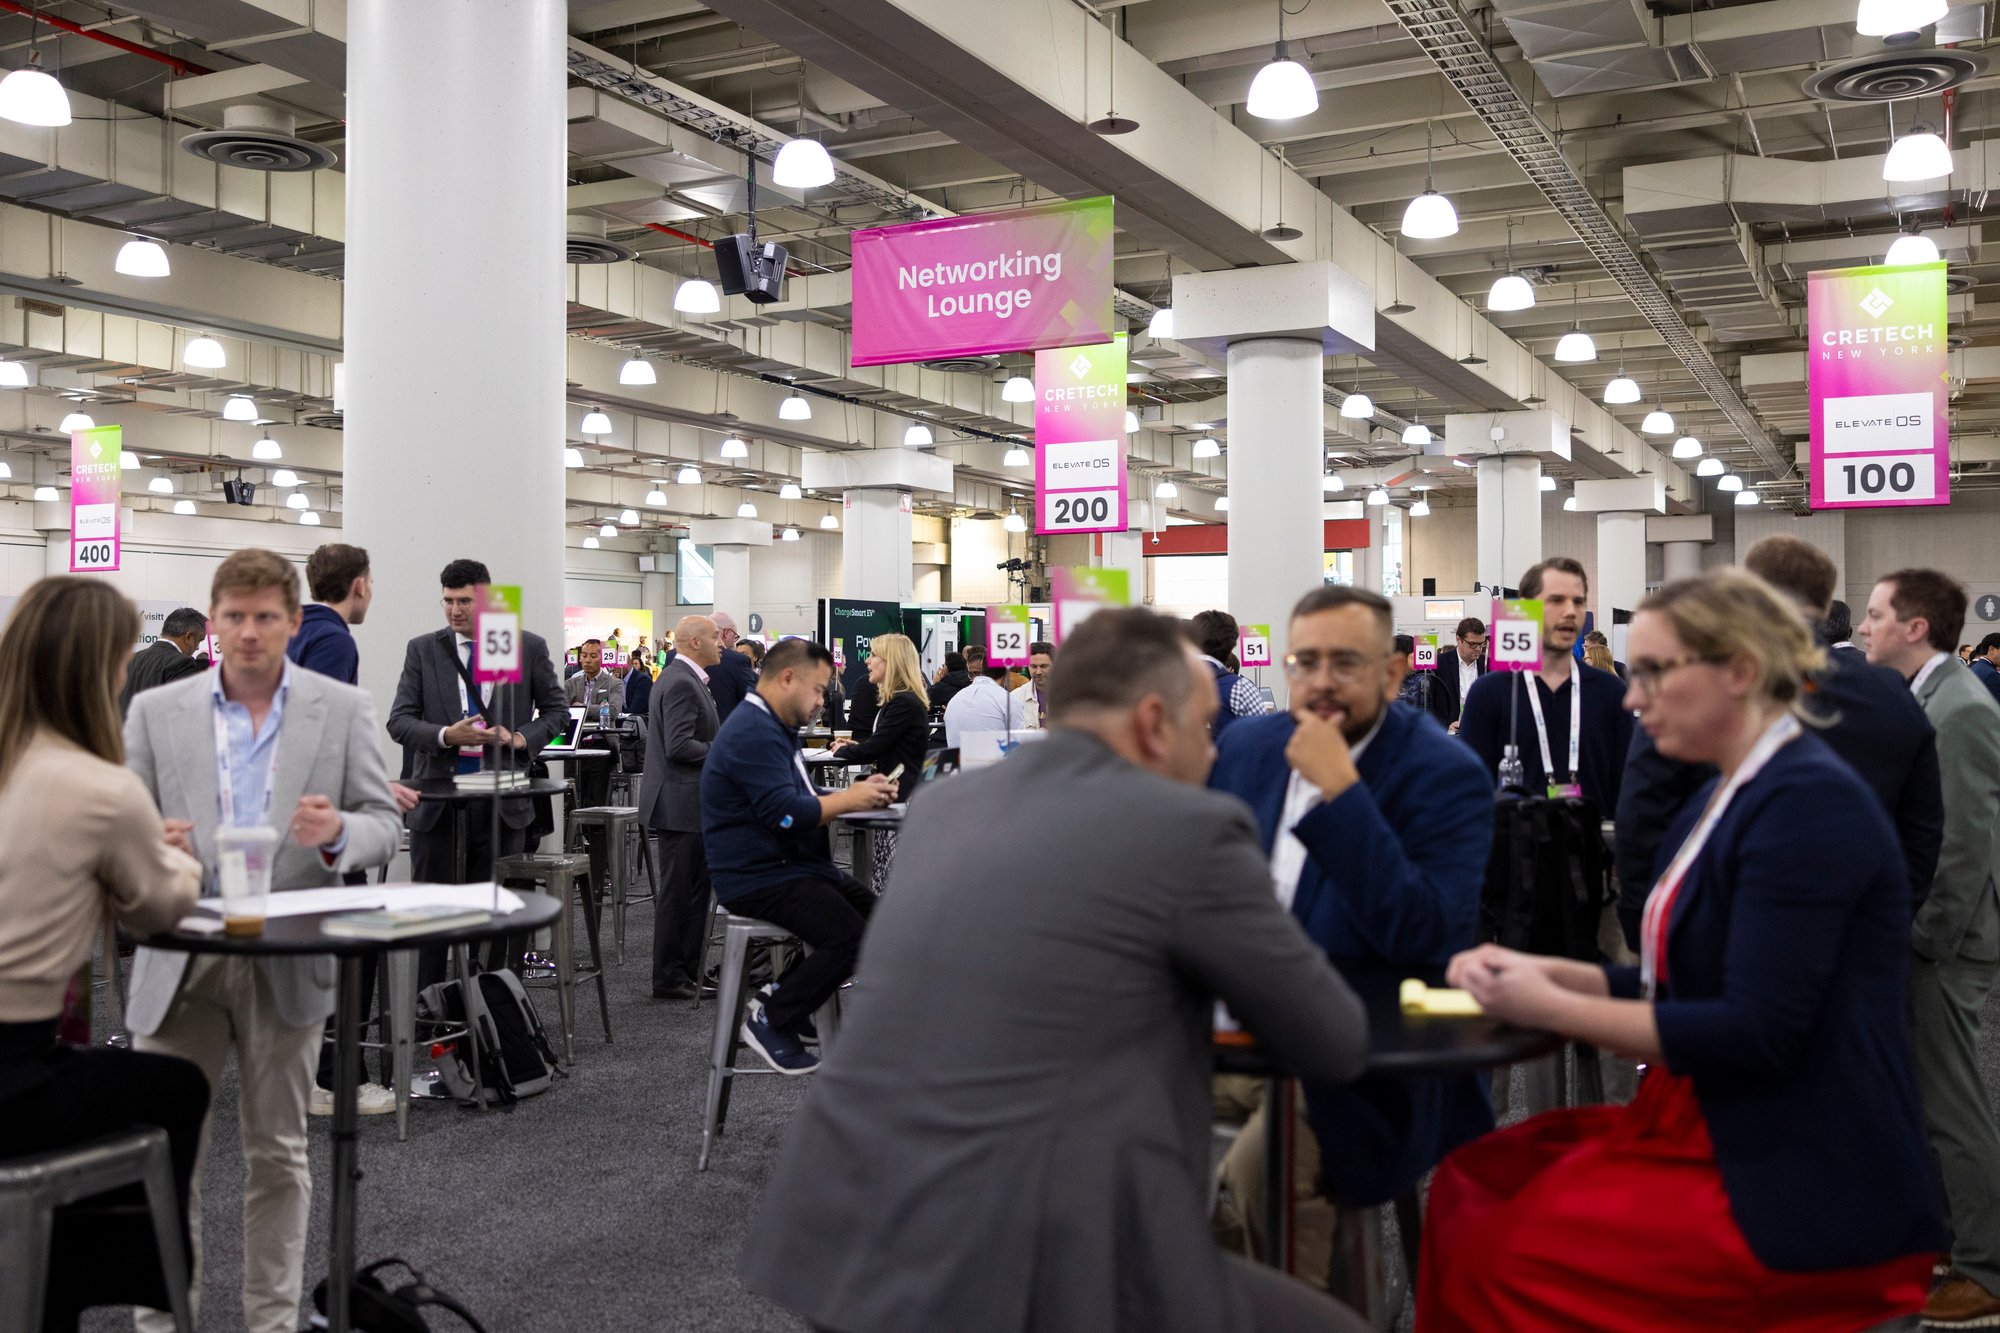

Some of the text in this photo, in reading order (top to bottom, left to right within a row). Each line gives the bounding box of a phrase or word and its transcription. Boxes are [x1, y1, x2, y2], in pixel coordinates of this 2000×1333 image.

[899, 250, 1062, 290] Networking
[928, 288, 1032, 319] Lounge
[1822, 323, 1934, 346] CRETECH
[1822, 344, 1934, 360] NEW YORK
[1044, 383, 1119, 402] CRETECH
[1044, 400, 1118, 414] NEW YORK
[1835, 415, 1922, 429] ELEVATE OS
[76, 462, 117, 475] CRETECH
[1052, 458, 1110, 469] ELEVATE OS
[96, 474, 117, 482] YORK
[1842, 462, 1916, 495] 100
[1055, 496, 1109, 524] 200
[80, 514, 111, 525] ELEVATE OS
[79, 544, 111, 564] 400
[144, 611, 165, 621] visitt
[834, 607, 867, 618] ChargeSmart
[213, 641, 223, 654] 3
[486, 630, 512, 655] 53
[996, 633, 1021, 650] 52
[1502, 632, 1531, 651] 55
[603, 652, 614, 661] 29
[835, 650, 841, 659] 36
[1247, 643, 1263, 656] 51
[1418, 650, 1432, 660] 50
